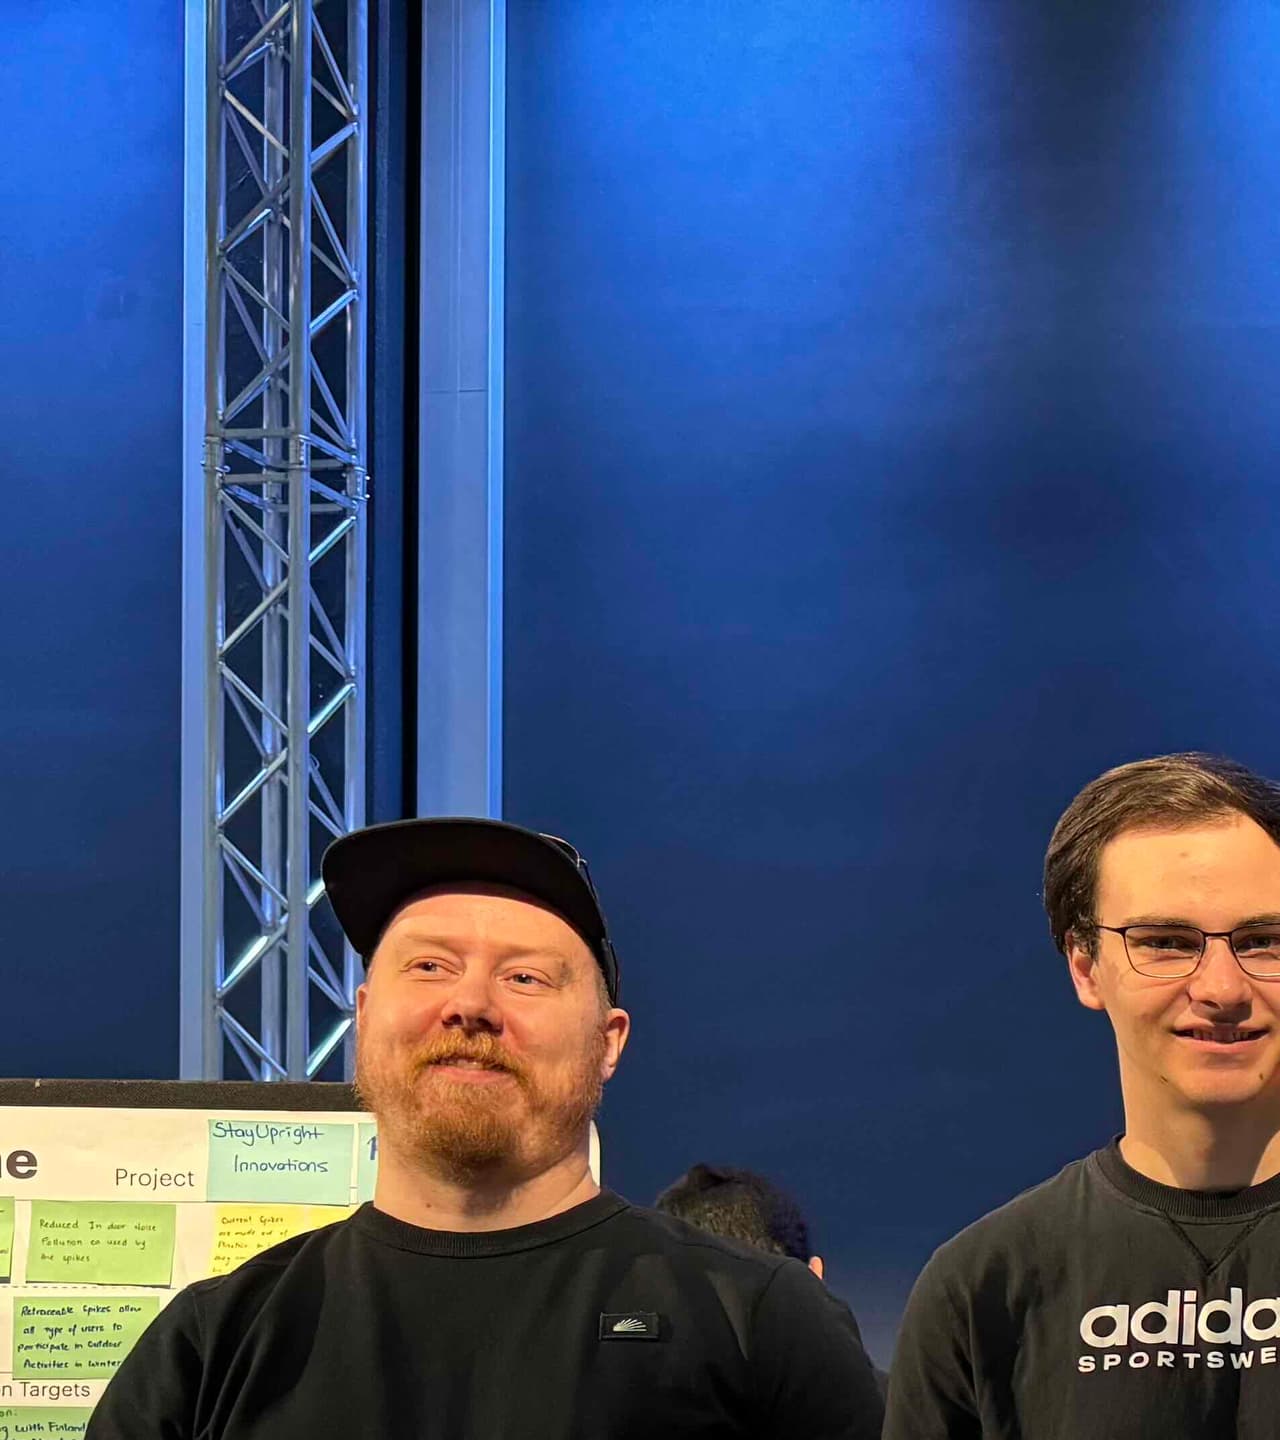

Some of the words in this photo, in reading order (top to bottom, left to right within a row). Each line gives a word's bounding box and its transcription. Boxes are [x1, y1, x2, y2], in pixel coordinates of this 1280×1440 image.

[233, 1155, 329, 1174] Innovations
[115, 1168, 195, 1190] Project
[39, 1219, 79, 1229] Reduced
[19, 1382, 91, 1401] Targets
